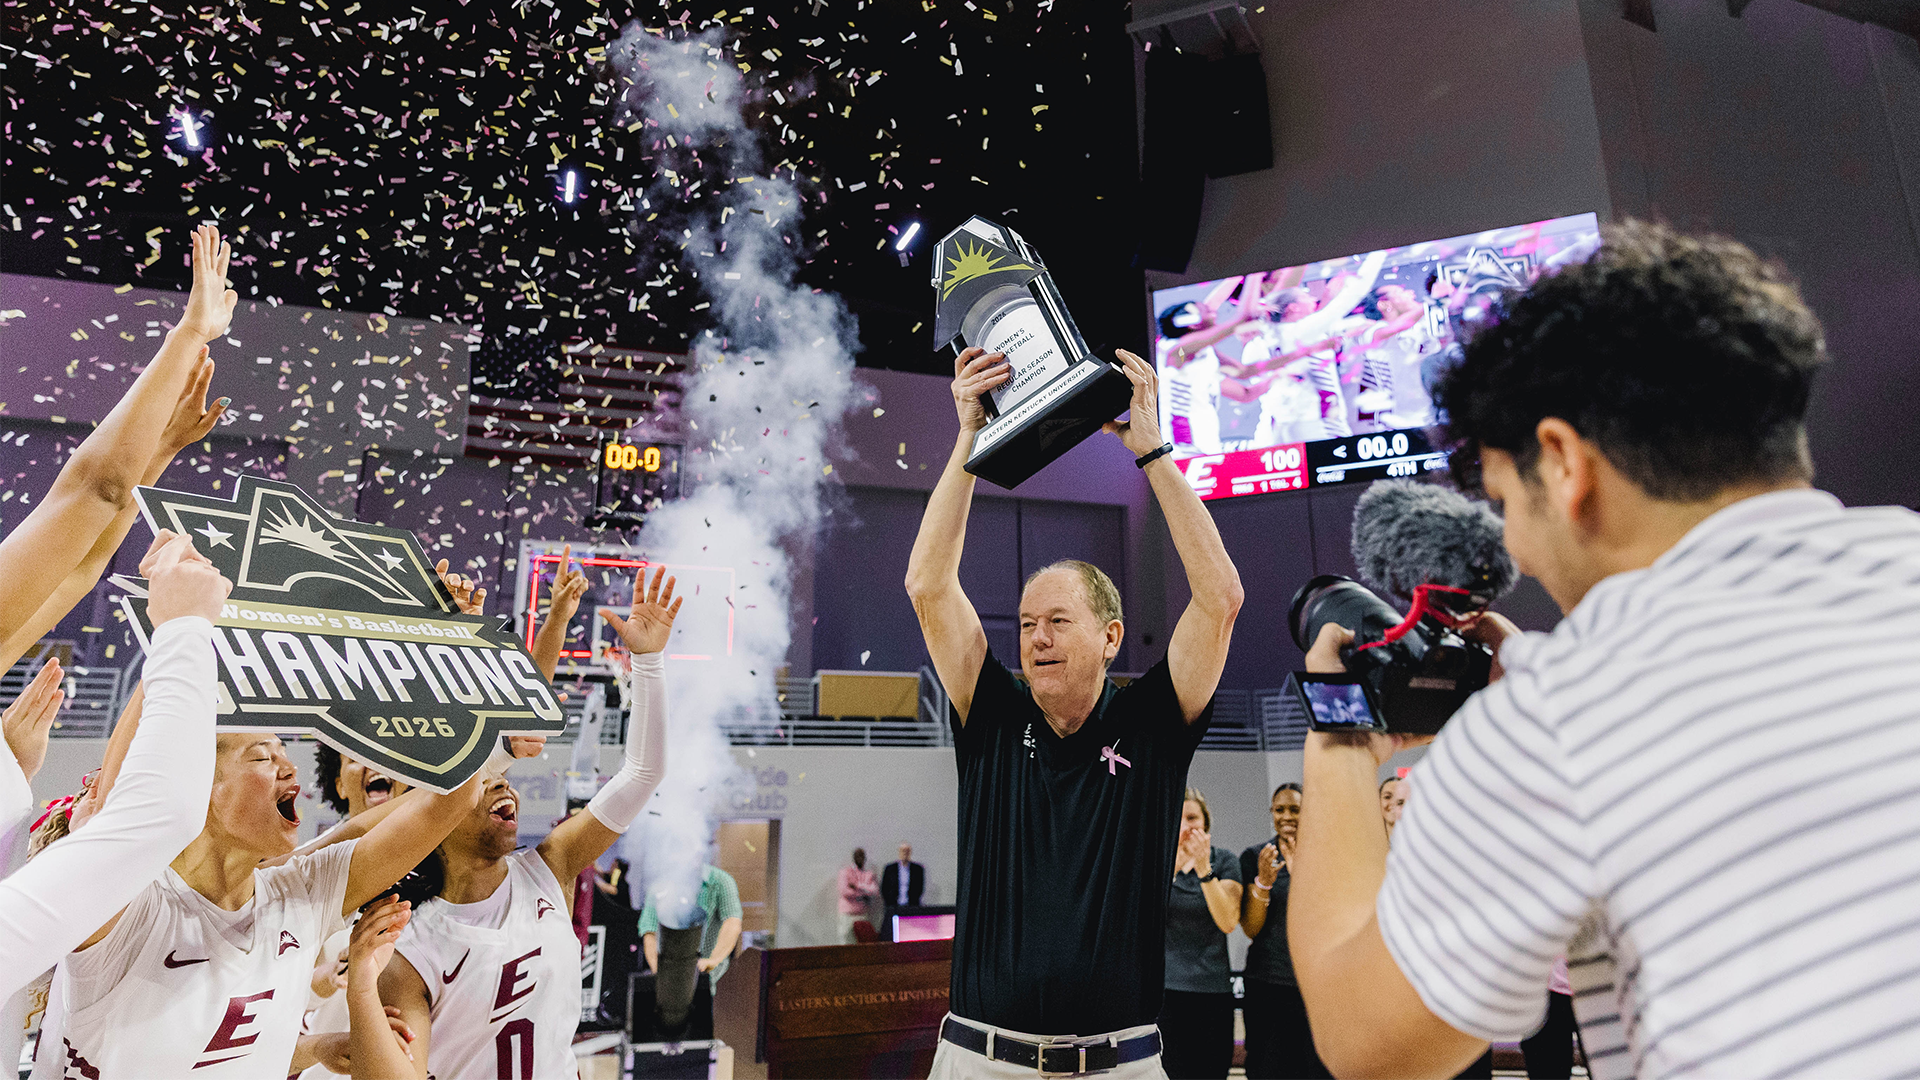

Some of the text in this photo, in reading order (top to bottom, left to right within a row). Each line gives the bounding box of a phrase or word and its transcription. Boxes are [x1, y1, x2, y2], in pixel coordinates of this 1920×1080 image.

[994, 328, 1025, 352] WOMEN'S
[1003, 333, 1036, 358] KETBALL
[996, 348, 1054, 393] REGULAR SEASON
[1011, 365, 1047, 393] CHAMPION
[984, 367, 1087, 442] EASTERN KENTUCKY UNIVERSITY
[1357, 433, 1409, 460] 00.0
[1260, 448, 1301, 472] 100
[1386, 460, 1418, 477] 4TH
[343, 615, 474, 640] Basketball
[369, 716, 456, 737] 2026
[493, 946, 542, 1011] E
[833, 991, 896, 1007] KENTUCKY
[202, 989, 275, 1053] E
